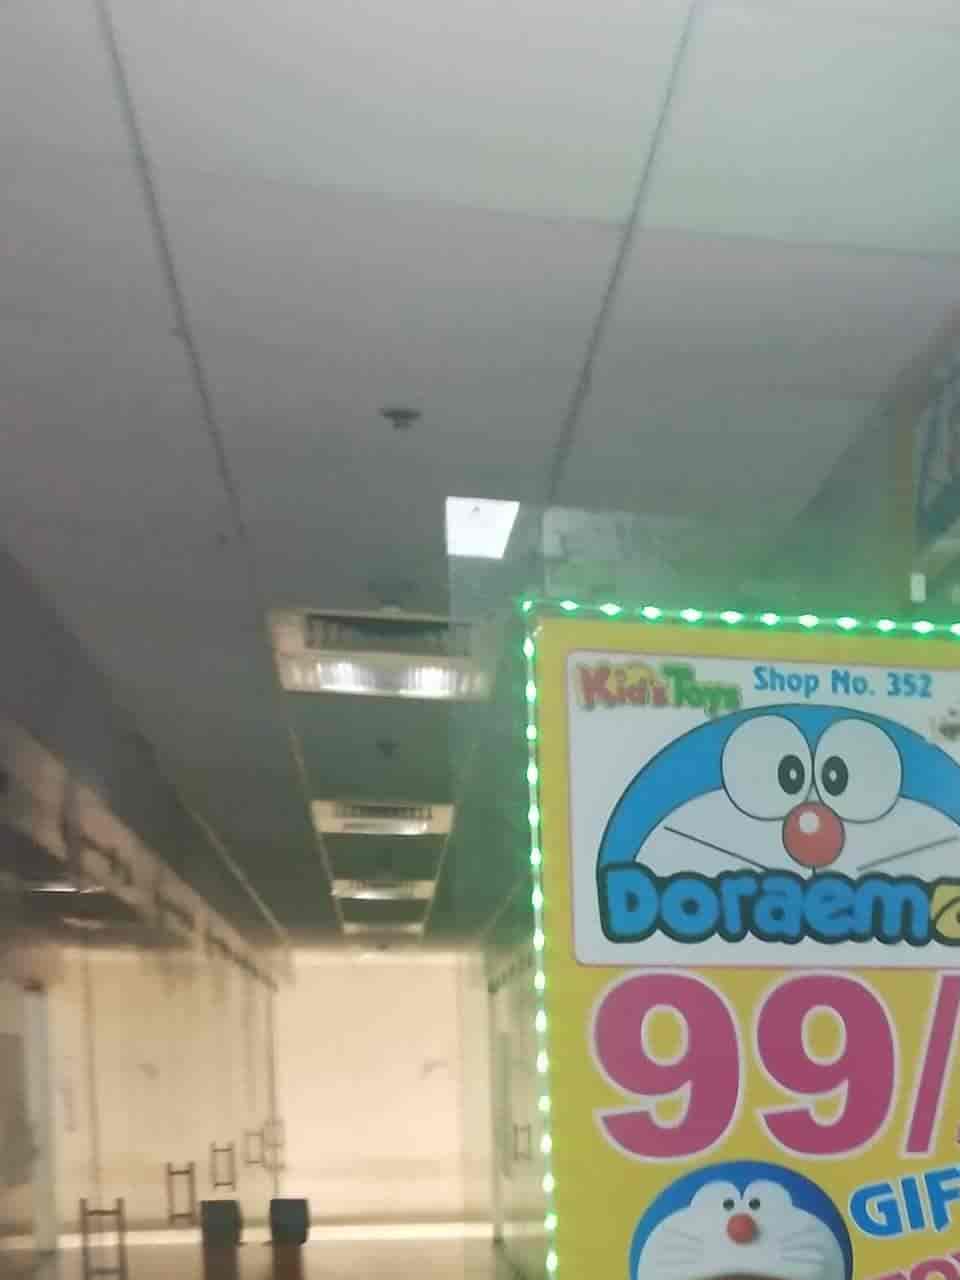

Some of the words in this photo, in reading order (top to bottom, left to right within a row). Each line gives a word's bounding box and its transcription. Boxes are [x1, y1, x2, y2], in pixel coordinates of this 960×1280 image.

[752, 665, 820, 700] Shop
[831, 669, 874, 697] No.
[886, 671, 933, 699] 352
